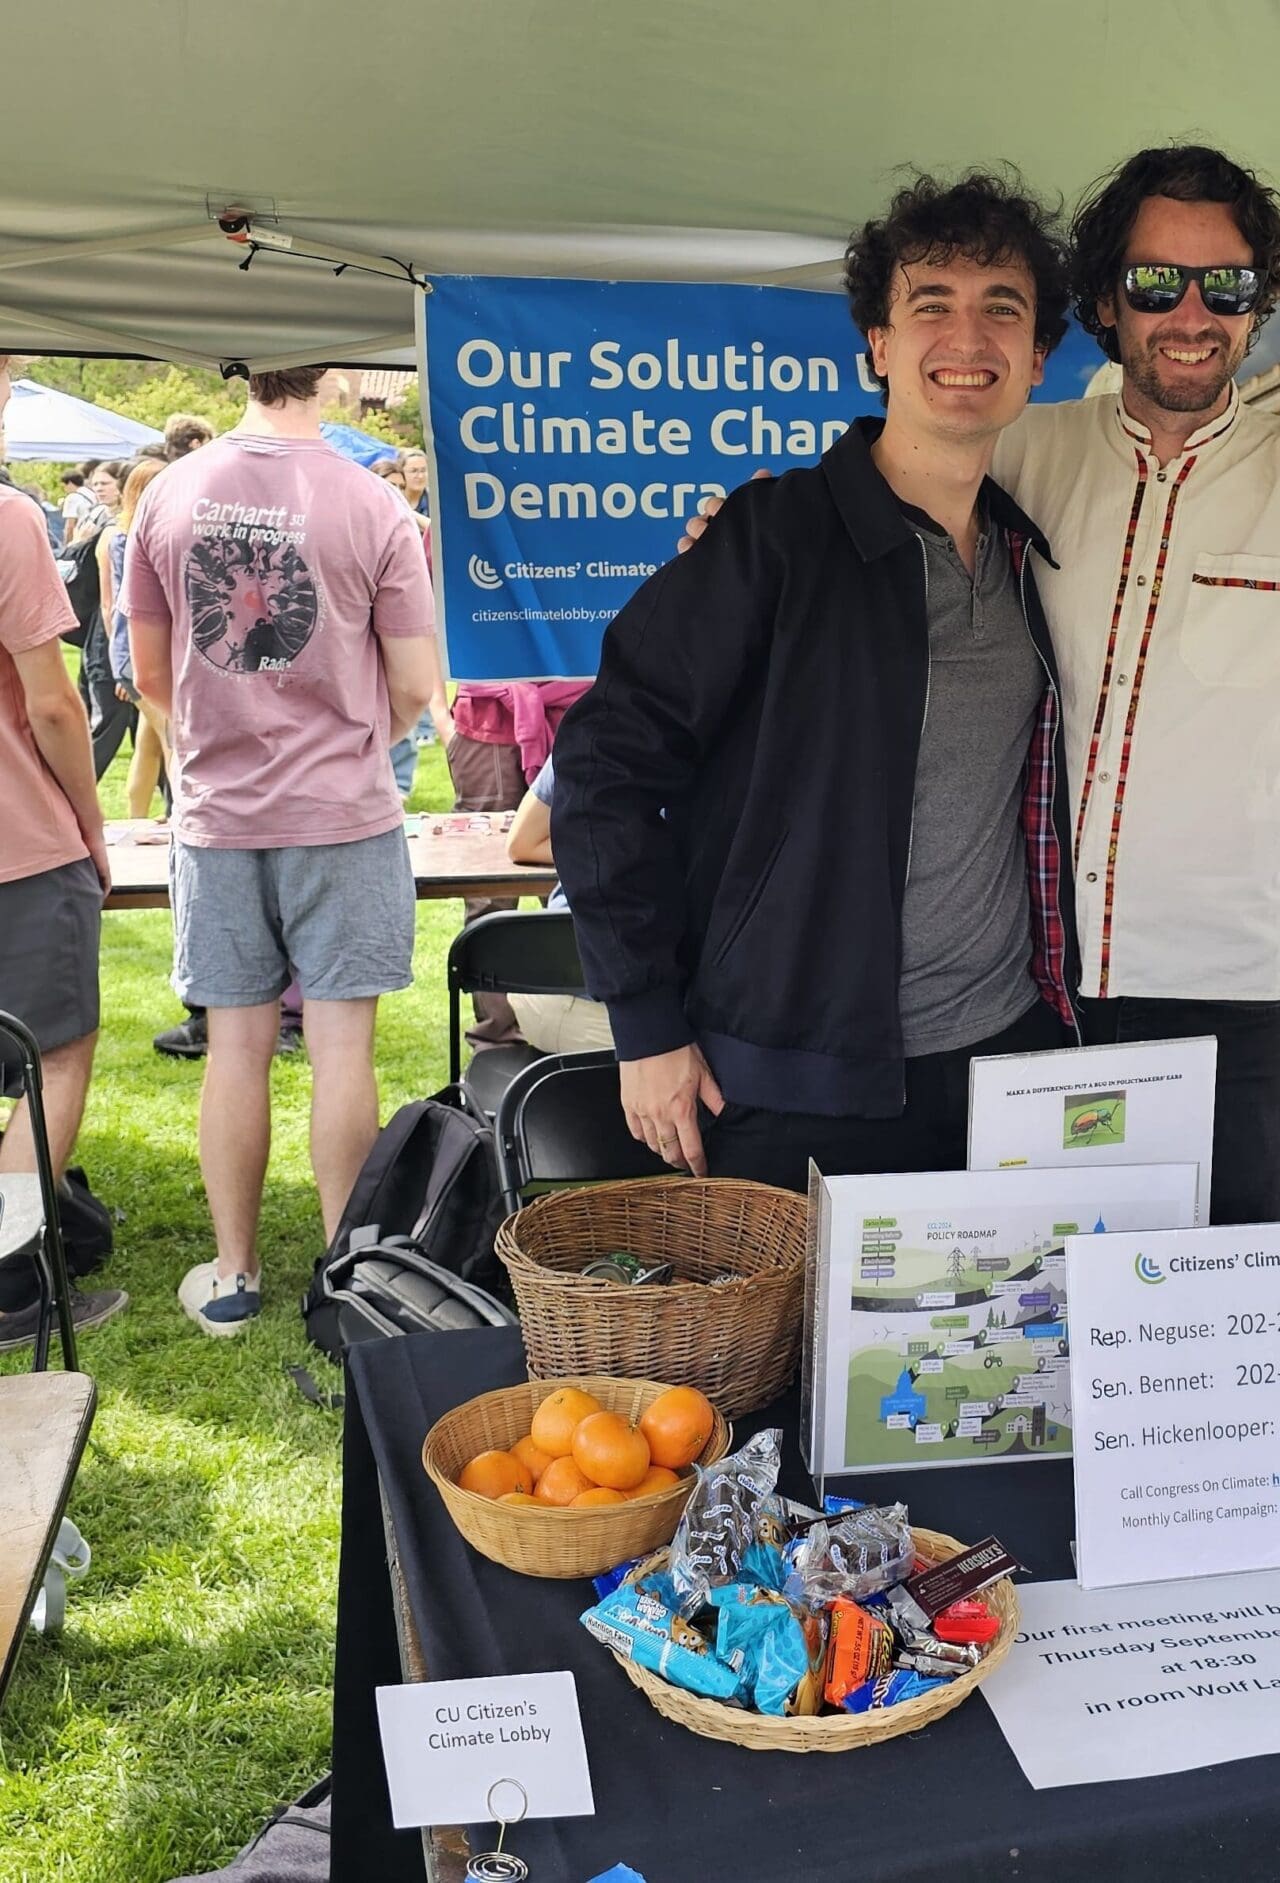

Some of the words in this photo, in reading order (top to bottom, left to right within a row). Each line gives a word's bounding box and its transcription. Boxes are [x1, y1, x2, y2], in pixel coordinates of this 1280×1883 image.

[457, 338, 571, 388] Our
[590, 338, 839, 393] Solution
[459, 402, 691, 455] Climate
[711, 405, 852, 456] Chan
[465, 472, 727, 520] Democra
[192, 498, 289, 528] Carhartt
[192, 522, 232, 537] work
[232, 523, 246, 539] in
[248, 526, 306, 544] progress
[504, 562, 581, 579] Citizens’
[586, 561, 657, 578] Climate
[927, 1231, 955, 1241] POLICY
[957, 1229, 997, 1239] ROADMAP
[1169, 1254, 1240, 1273] Citizens’
[1090, 1328, 1132, 1348] Rep.
[1139, 1321, 1215, 1345] Neguse:
[1091, 1378, 1133, 1399] Sen.
[1140, 1371, 1214, 1394] Bennet:
[1094, 1430, 1135, 1452] Sen.
[1142, 1420, 1275, 1448] Hickenlooper:
[1120, 1487, 1142, 1501] Call
[1145, 1481, 1200, 1500] Congress
[1202, 1480, 1220, 1492] On
[1222, 1475, 1269, 1491] Climate:
[1122, 1512, 1170, 1529] Monthly
[1173, 1508, 1214, 1525] Calling
[1216, 1503, 1278, 1521] Campaign:
[588, 1617, 615, 1635] Nutrition
[614, 1630, 632, 1645] Facts
[1060, 1621, 1113, 1638] first
[1118, 1610, 1216, 1630] meeting
[1219, 1604, 1264, 1621] will
[1039, 1640, 1156, 1667] Thursday
[1160, 1661, 1186, 1675] at
[1189, 1653, 1257, 1672] 18:30
[1086, 1700, 1112, 1715] in
[1116, 1688, 1186, 1711] room
[1188, 1680, 1249, 1698] Wolf
[435, 1707, 461, 1724] CU
[466, 1700, 537, 1721] Citizen’s
[428, 1730, 495, 1750] Climate
[499, 1725, 551, 1743] Lobby
